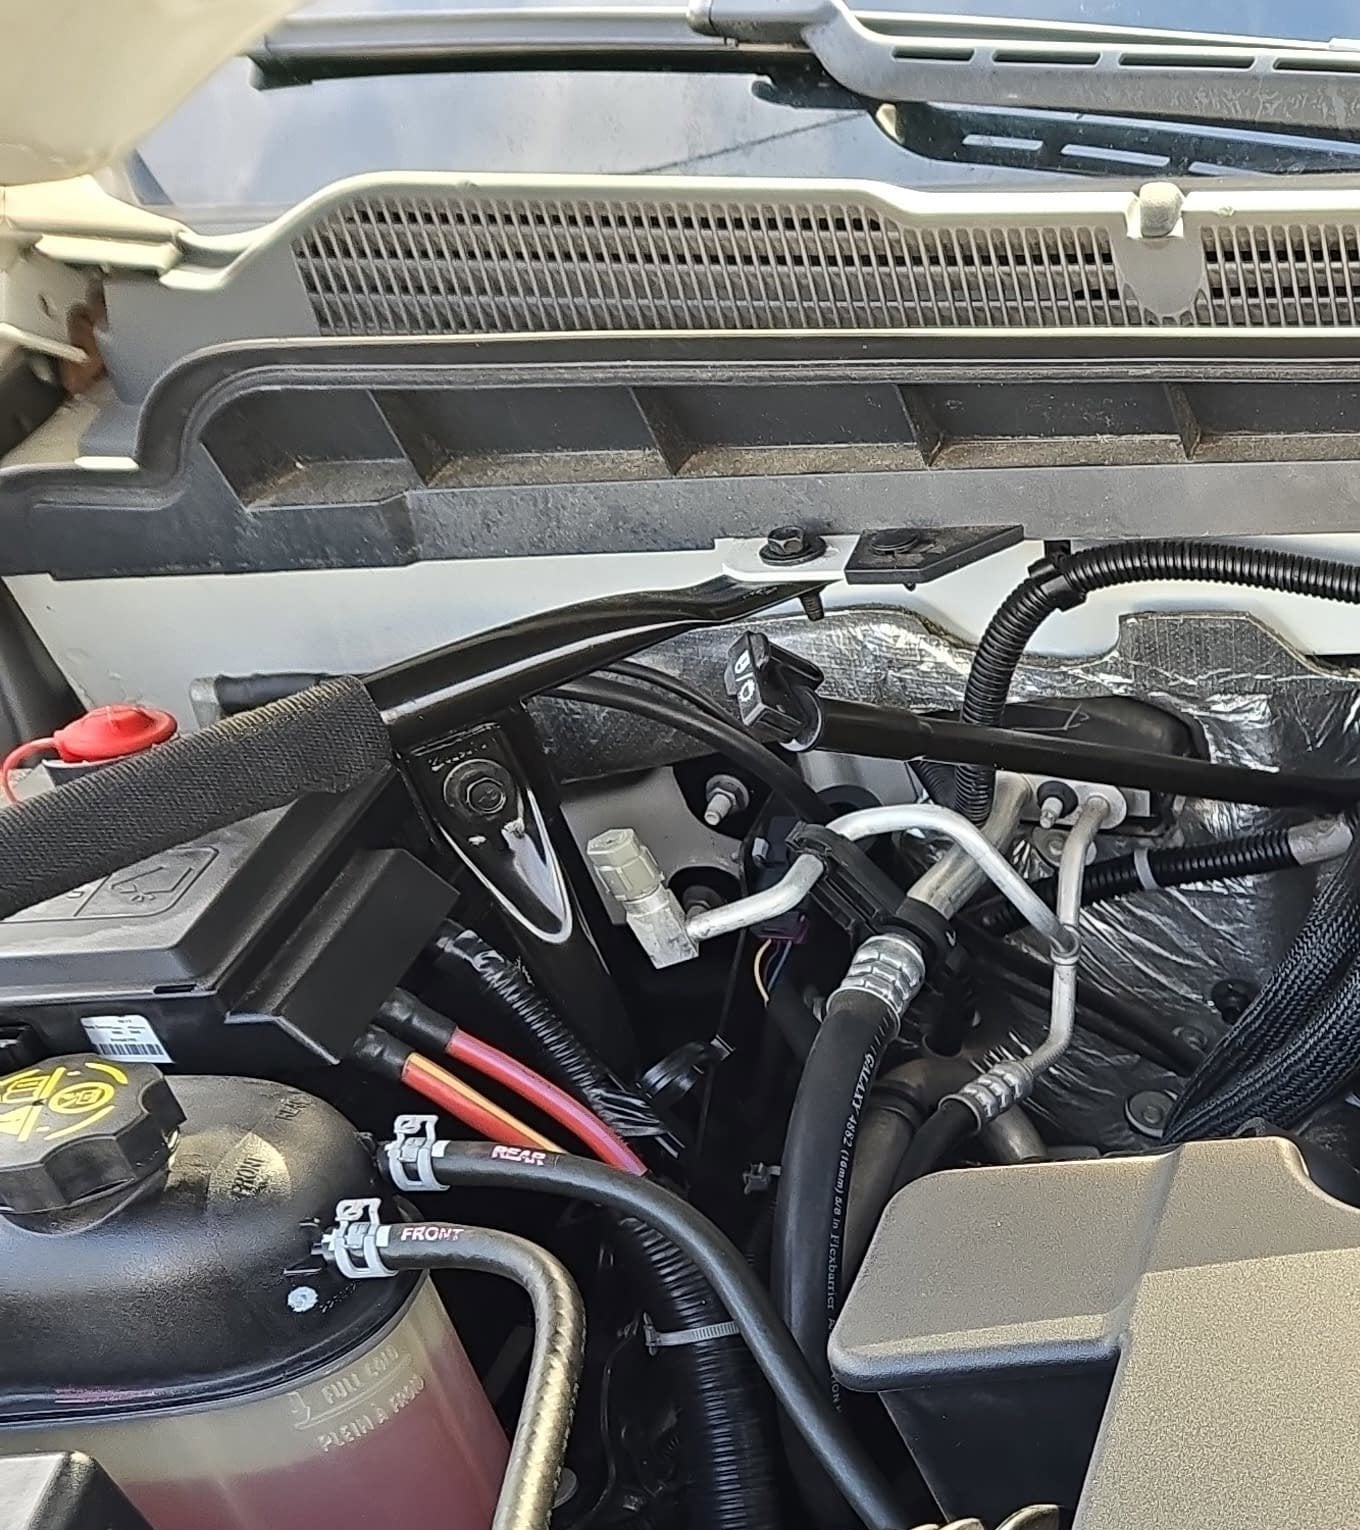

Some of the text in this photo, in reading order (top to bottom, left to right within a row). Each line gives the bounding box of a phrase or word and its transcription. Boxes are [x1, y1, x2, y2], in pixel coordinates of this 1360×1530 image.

[852, 1053, 876, 1116] GALAXY
[843, 1114, 859, 1147] 4882
[491, 1145, 546, 1166] REAR
[833, 1197, 843, 1216] 5/8
[401, 1226, 465, 1241] FRONT
[322, 1373, 364, 1404] FULL
[318, 1414, 375, 1451] PLEIN
